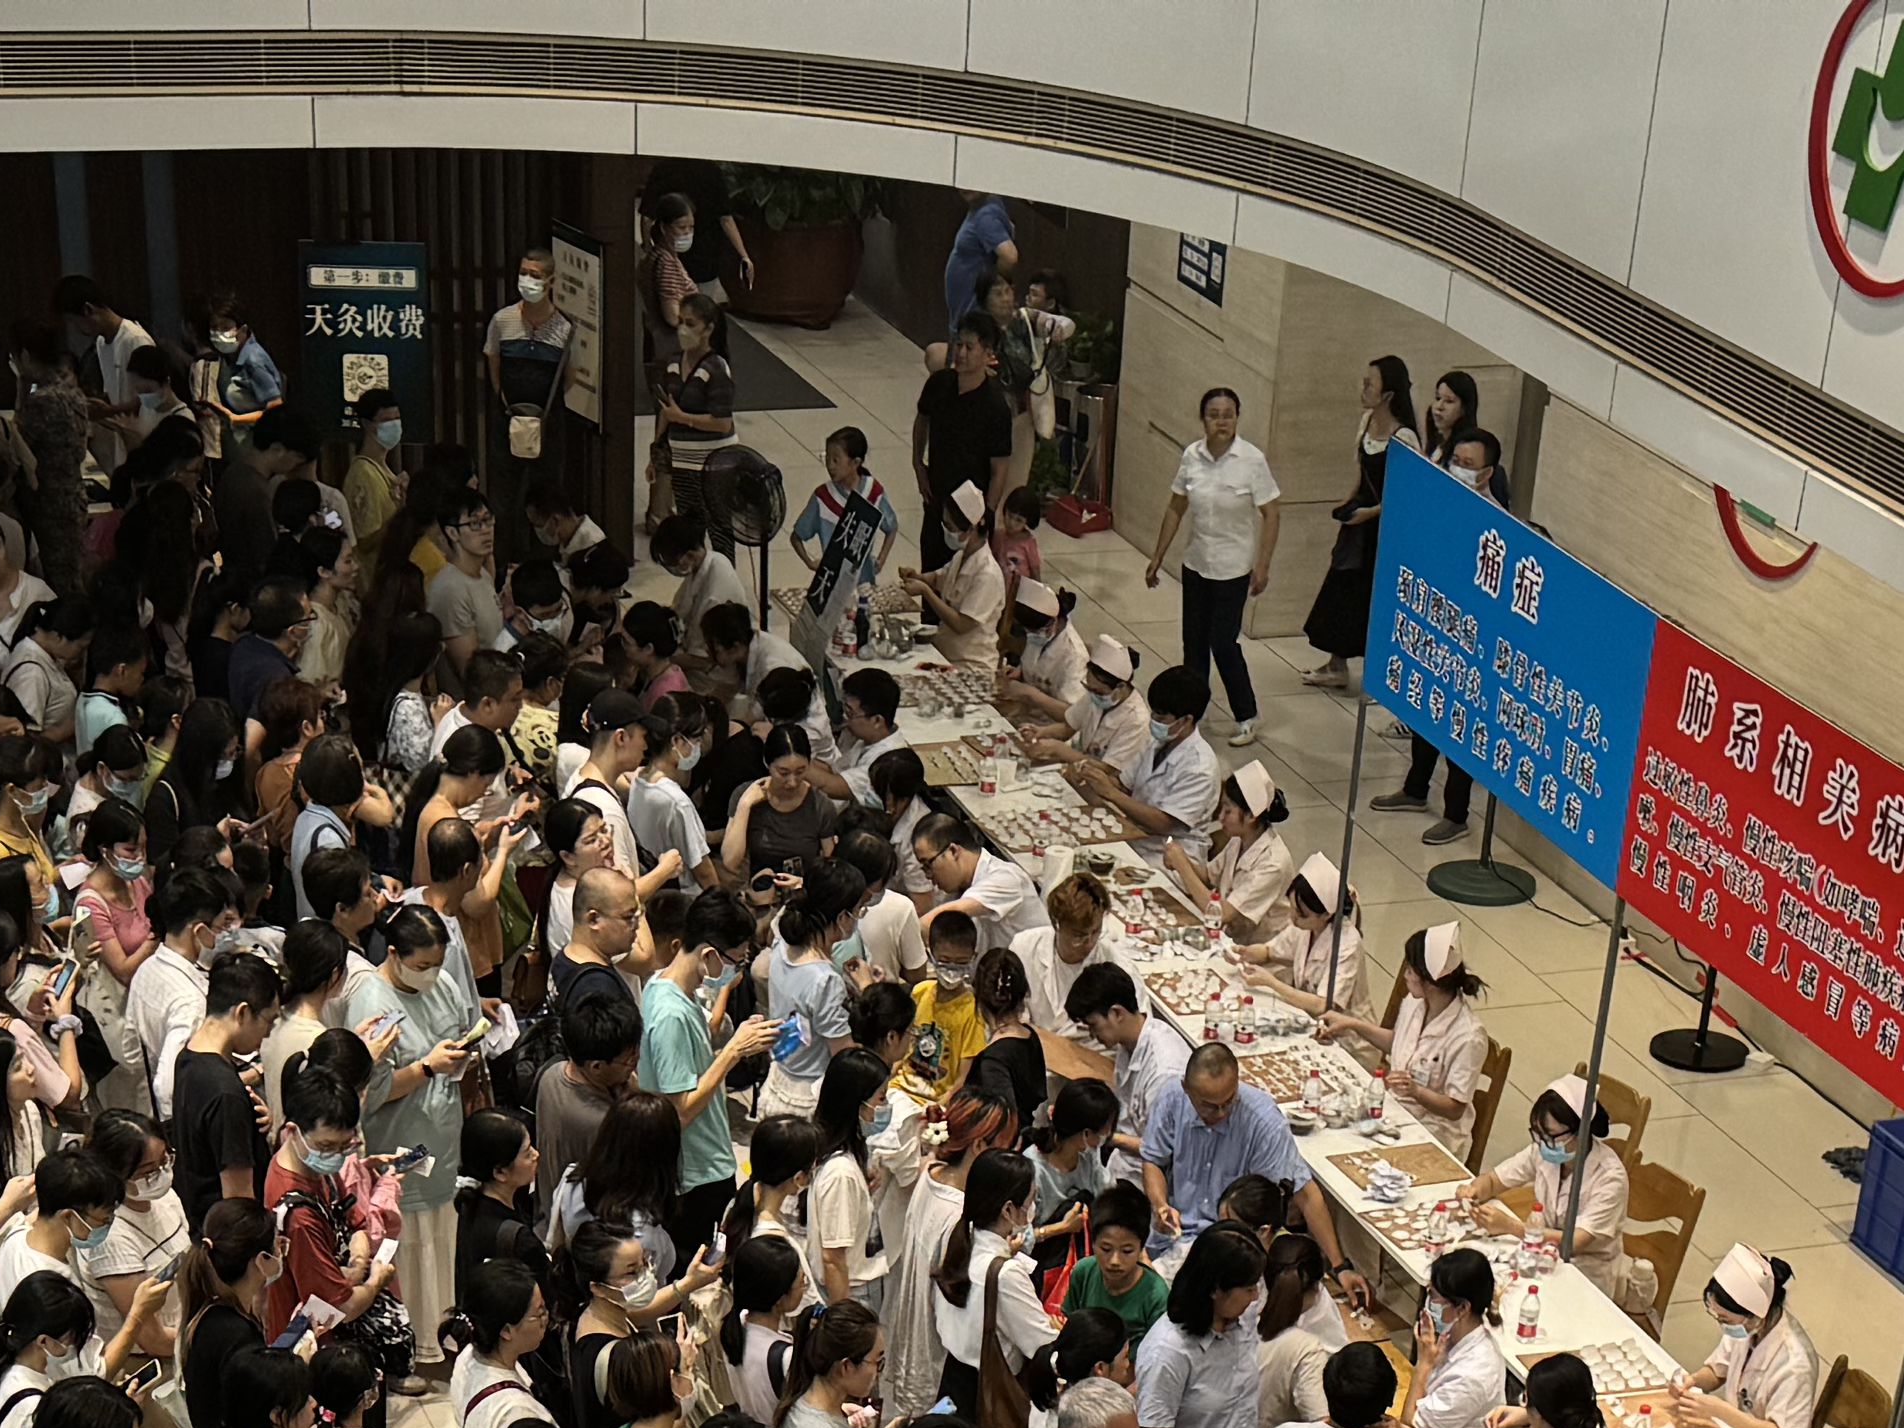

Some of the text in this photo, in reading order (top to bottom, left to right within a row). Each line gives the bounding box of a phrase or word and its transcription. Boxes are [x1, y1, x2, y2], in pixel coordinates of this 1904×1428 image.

[304, 302, 426, 340] 天灸收费
[1474, 528, 1545, 625] 痛症
